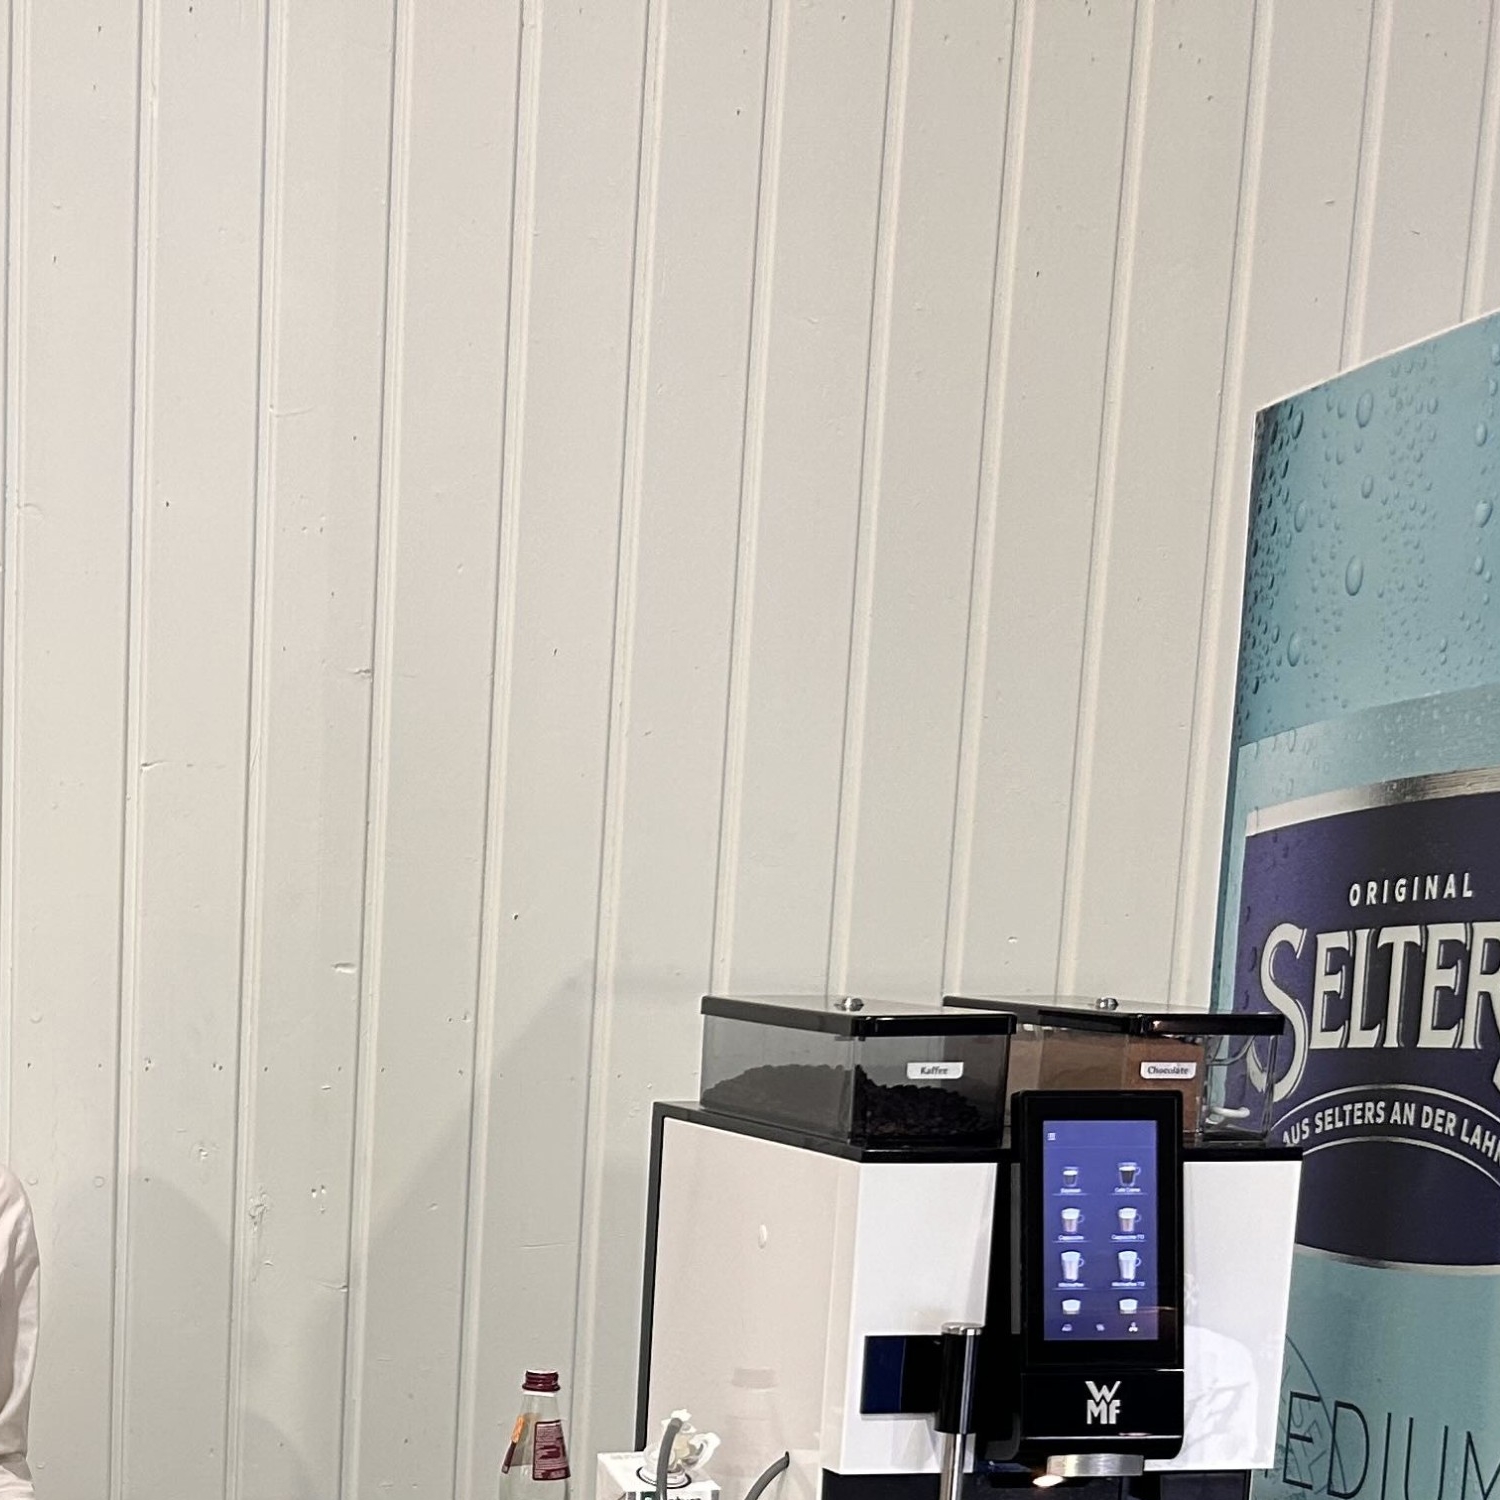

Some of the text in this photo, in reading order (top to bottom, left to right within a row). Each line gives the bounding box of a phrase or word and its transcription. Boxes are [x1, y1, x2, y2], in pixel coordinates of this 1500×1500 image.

[1349, 872, 1473, 907] ORIGINAL
[1246, 922, 1500, 1102] SELTER
[1147, 1065, 1189, 1075] Chocolate
[1282, 1118, 1310, 1147] AUS
[1314, 1101, 1386, 1134] SELTERS
[1389, 1101, 1416, 1126] AN
[1420, 1105, 1457, 1136] DER
